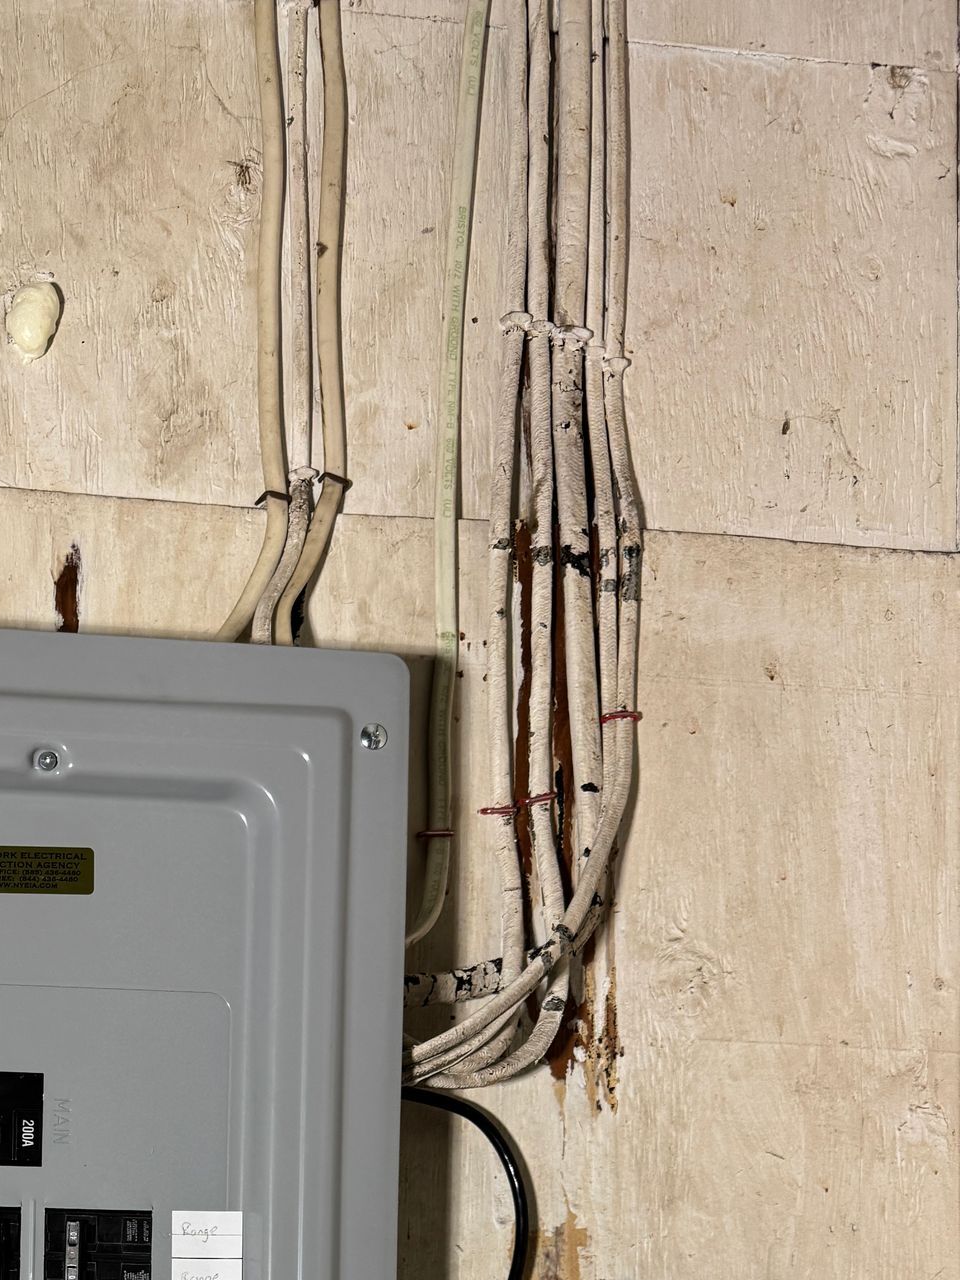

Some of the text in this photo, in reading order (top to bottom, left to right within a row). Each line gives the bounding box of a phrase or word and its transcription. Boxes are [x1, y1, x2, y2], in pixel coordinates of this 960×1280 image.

[470, 32, 482, 67] VOLTS
[466, 75, 476, 96] (UL)
[455, 206, 467, 249] BRISTOL
[453, 259, 463, 279] 10/2
[451, 284, 461, 312] WITH
[447, 316, 460, 361] GROUND
[447, 371, 457, 396] TYPE
[444, 458, 454, 490] VOLTS
[442, 498, 453, 519] (UL)
[20, 852, 87, 861] ELECTRICAL
[37, 861, 80, 869] AGENCY
[21, 1118, 35, 1148] 200A
[52, 1097, 73, 1145] MAIN
[69, 1231, 77, 1241] 40
[181, 1221, 219, 1244] Range
